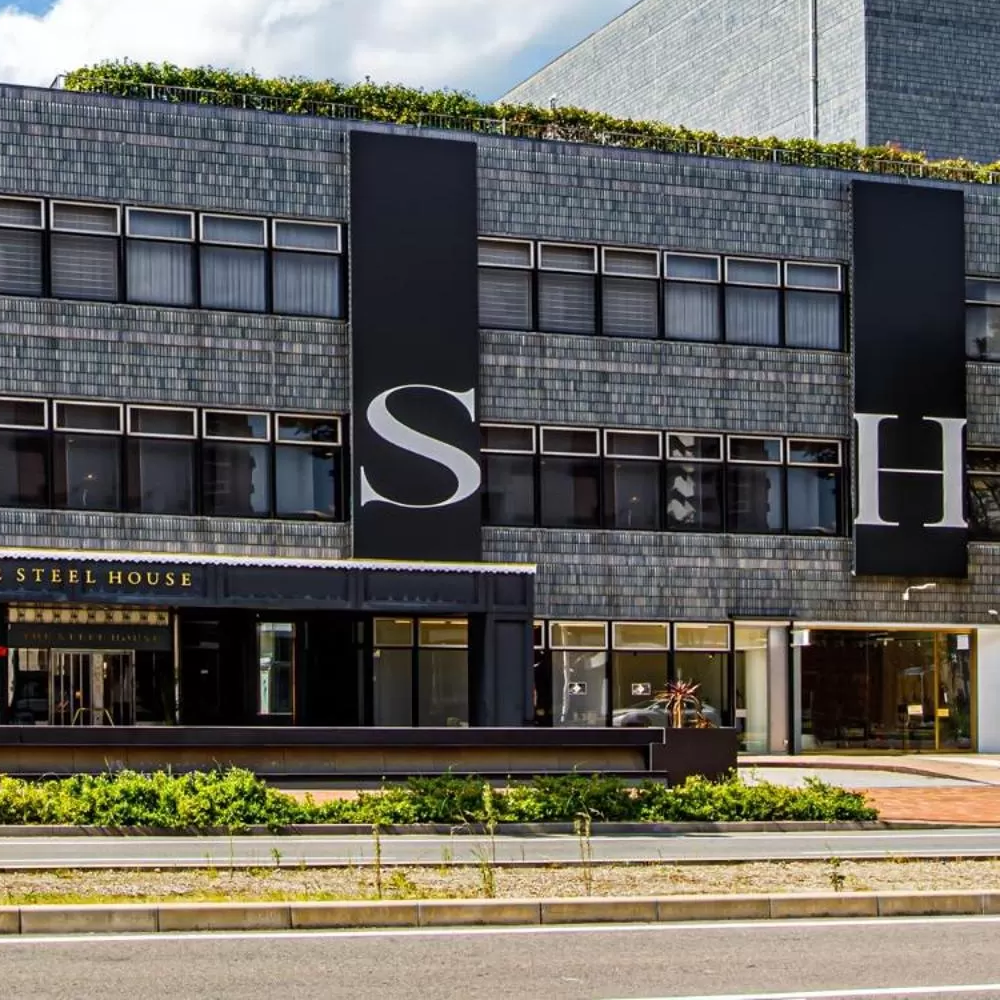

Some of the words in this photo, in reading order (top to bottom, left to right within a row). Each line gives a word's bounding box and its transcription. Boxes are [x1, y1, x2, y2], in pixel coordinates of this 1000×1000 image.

[360, 384, 481, 508] S
[853, 413, 968, 528] H
[16, 568, 96, 584] STEEL
[108, 571, 192, 586] HOUSE
